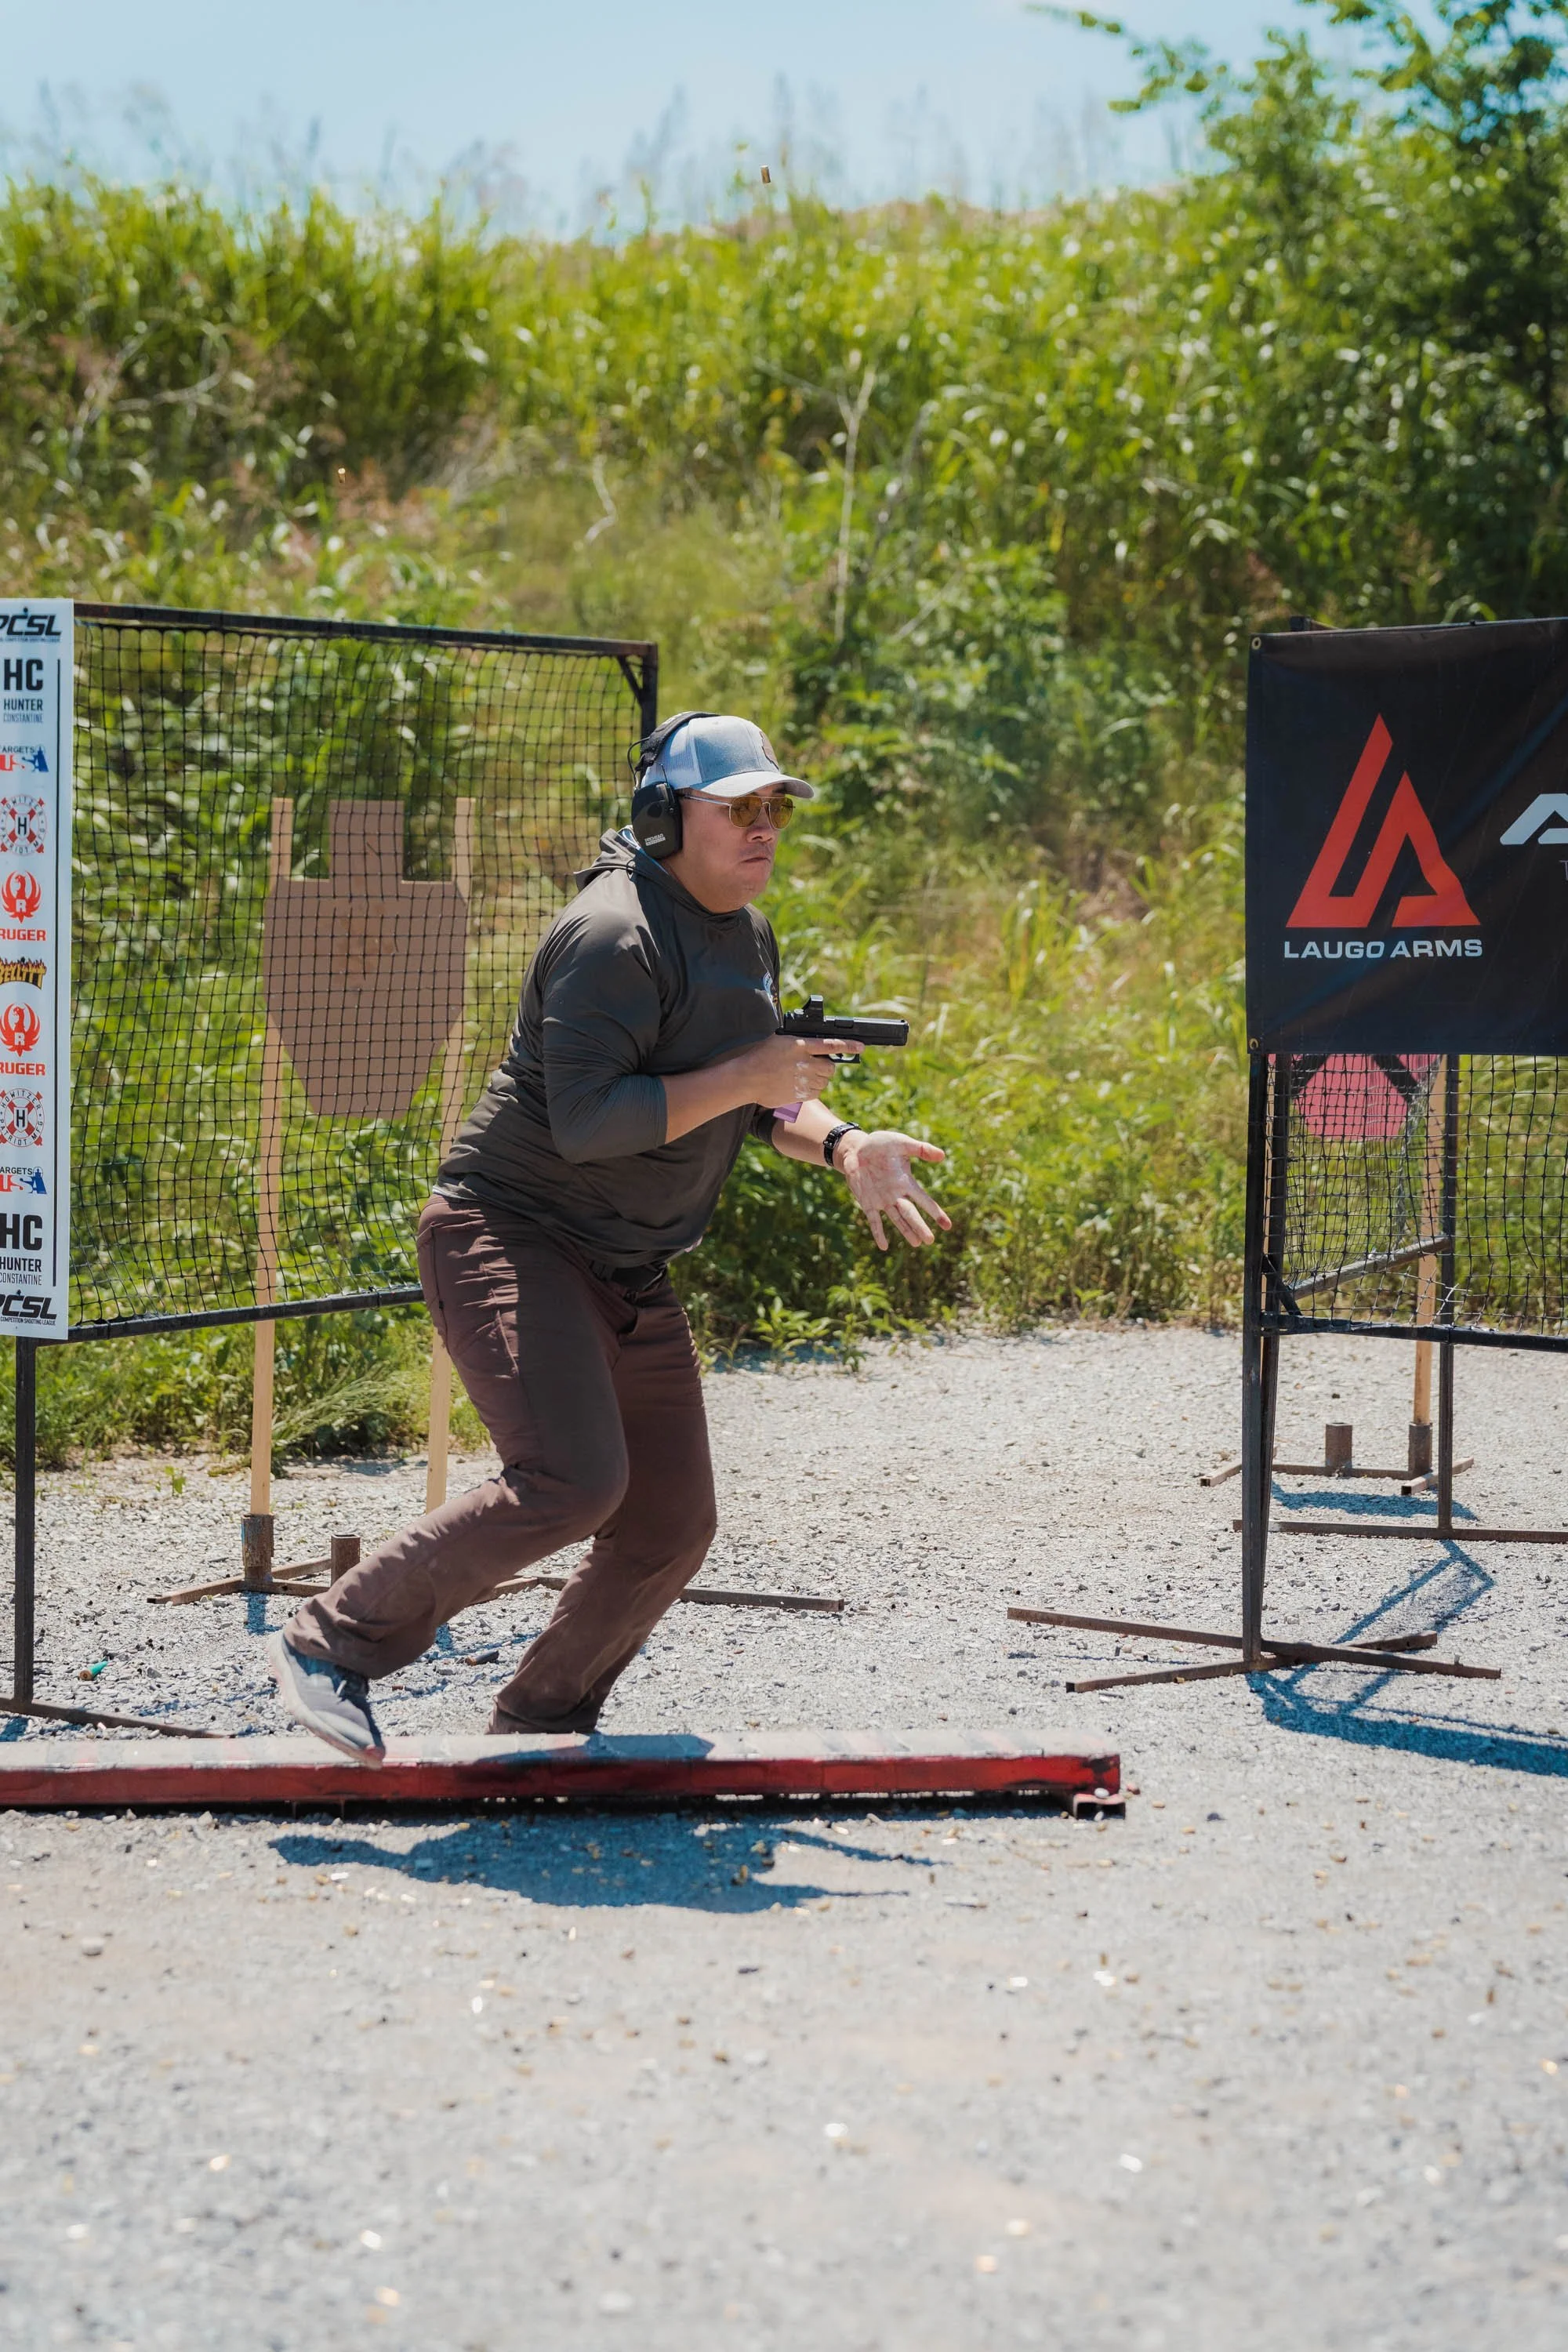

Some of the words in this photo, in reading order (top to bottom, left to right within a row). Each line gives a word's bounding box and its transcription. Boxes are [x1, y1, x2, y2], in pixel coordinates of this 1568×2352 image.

[4, 659, 43, 691] HC
[3, 699, 43, 711] HUNTER
[3, 713, 43, 723] CONSTANTINE
[17, 816, 27, 836] H
[1284, 942, 1385, 958] LAUGO
[1390, 940, 1483, 957] ARMS
[1, 1091, 42, 1110] HOWITZER
[16, 1109, 25, 1128] H
[0, 1213, 43, 1250] HC
[0, 1256, 42, 1272] HUNTER
